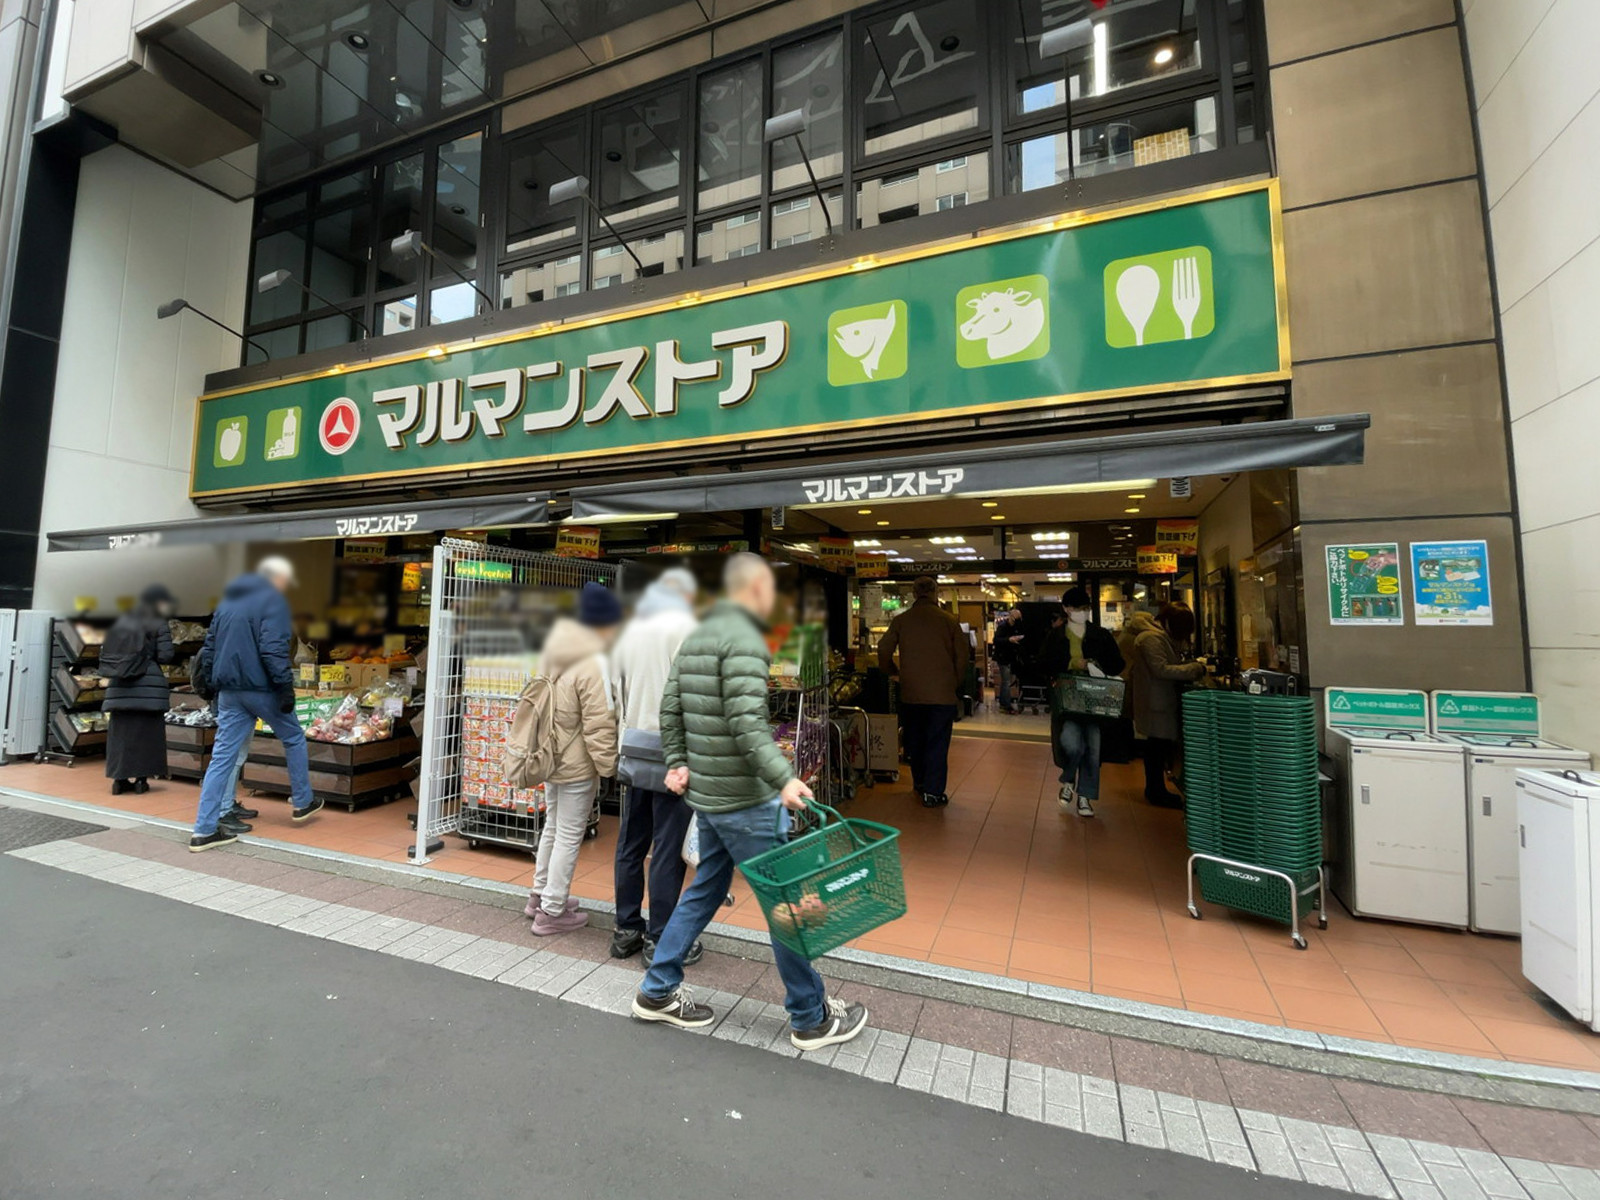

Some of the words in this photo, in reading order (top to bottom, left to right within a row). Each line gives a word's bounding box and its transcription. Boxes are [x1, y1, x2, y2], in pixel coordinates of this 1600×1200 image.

[372, 320, 789, 449] マルマンストア
[802, 468, 964, 503] マルマンストア
[335, 514, 418, 536] マルマンストア
[1082, 559, 1137, 568] マルマンスト
